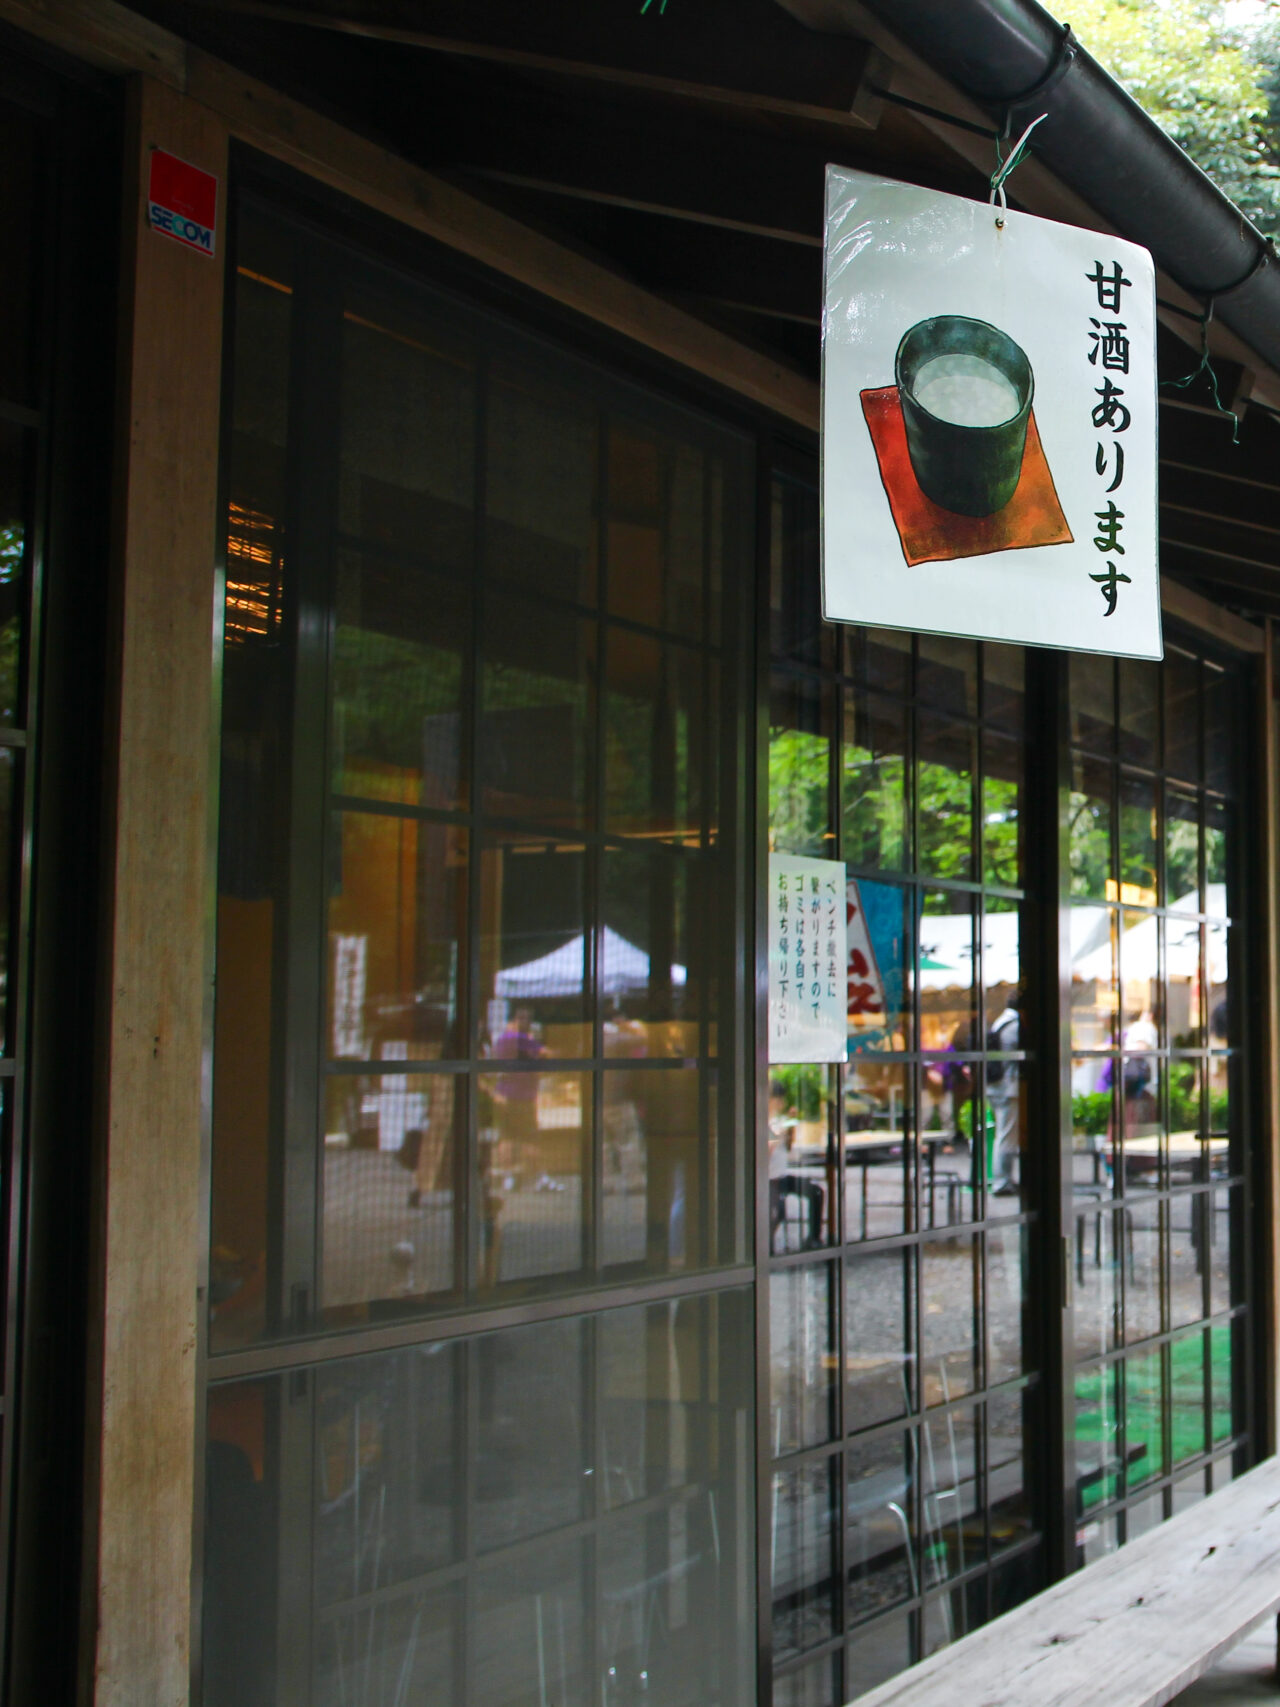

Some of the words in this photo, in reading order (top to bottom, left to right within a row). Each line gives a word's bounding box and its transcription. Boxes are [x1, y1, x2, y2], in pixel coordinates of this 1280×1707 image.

[151, 205, 211, 249] SECOM
[1084, 259, 1133, 618] 甘酒あります
